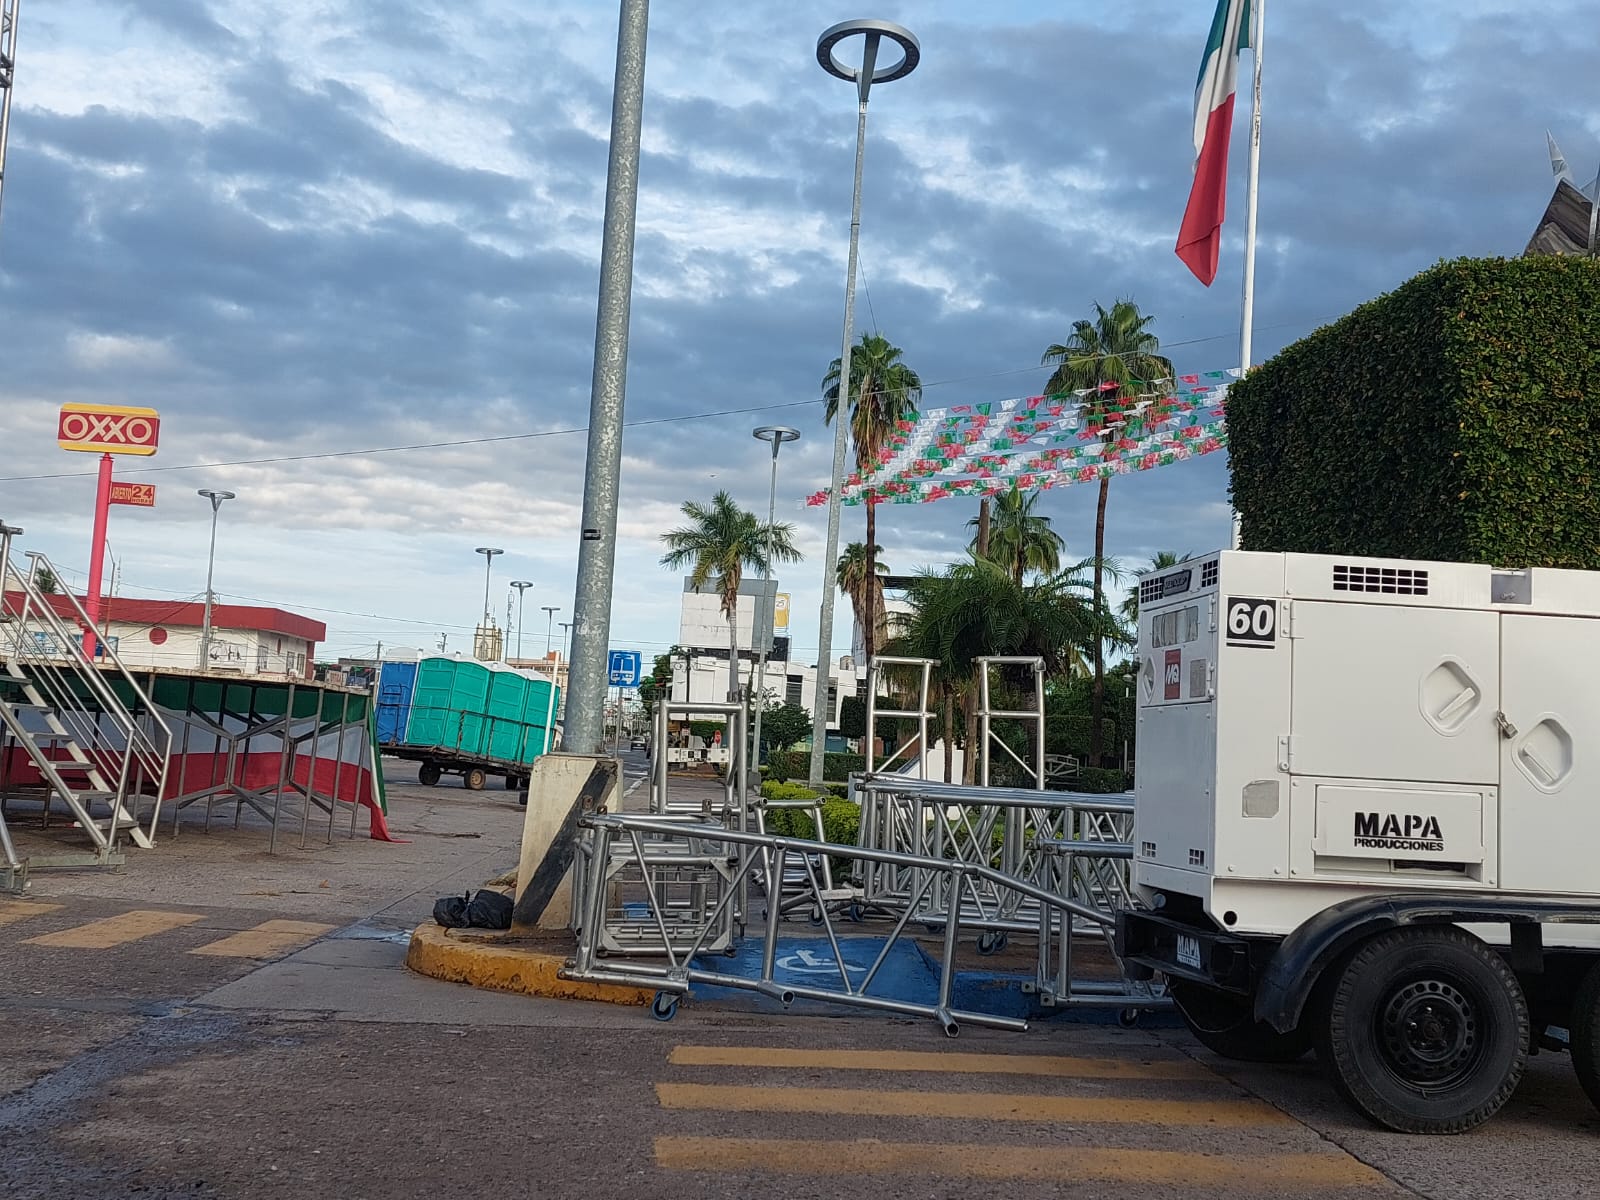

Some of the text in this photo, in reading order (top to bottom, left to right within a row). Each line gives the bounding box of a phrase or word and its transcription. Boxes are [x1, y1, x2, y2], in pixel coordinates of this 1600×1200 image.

[63, 414, 152, 443] OXXO
[132, 486, 152, 499] 24
[1229, 602, 1275, 636] 60
[1354, 812, 1443, 839] MAPA
[1354, 838, 1444, 852] PRODUCCIONES
[1177, 934, 1200, 958] MAPA
